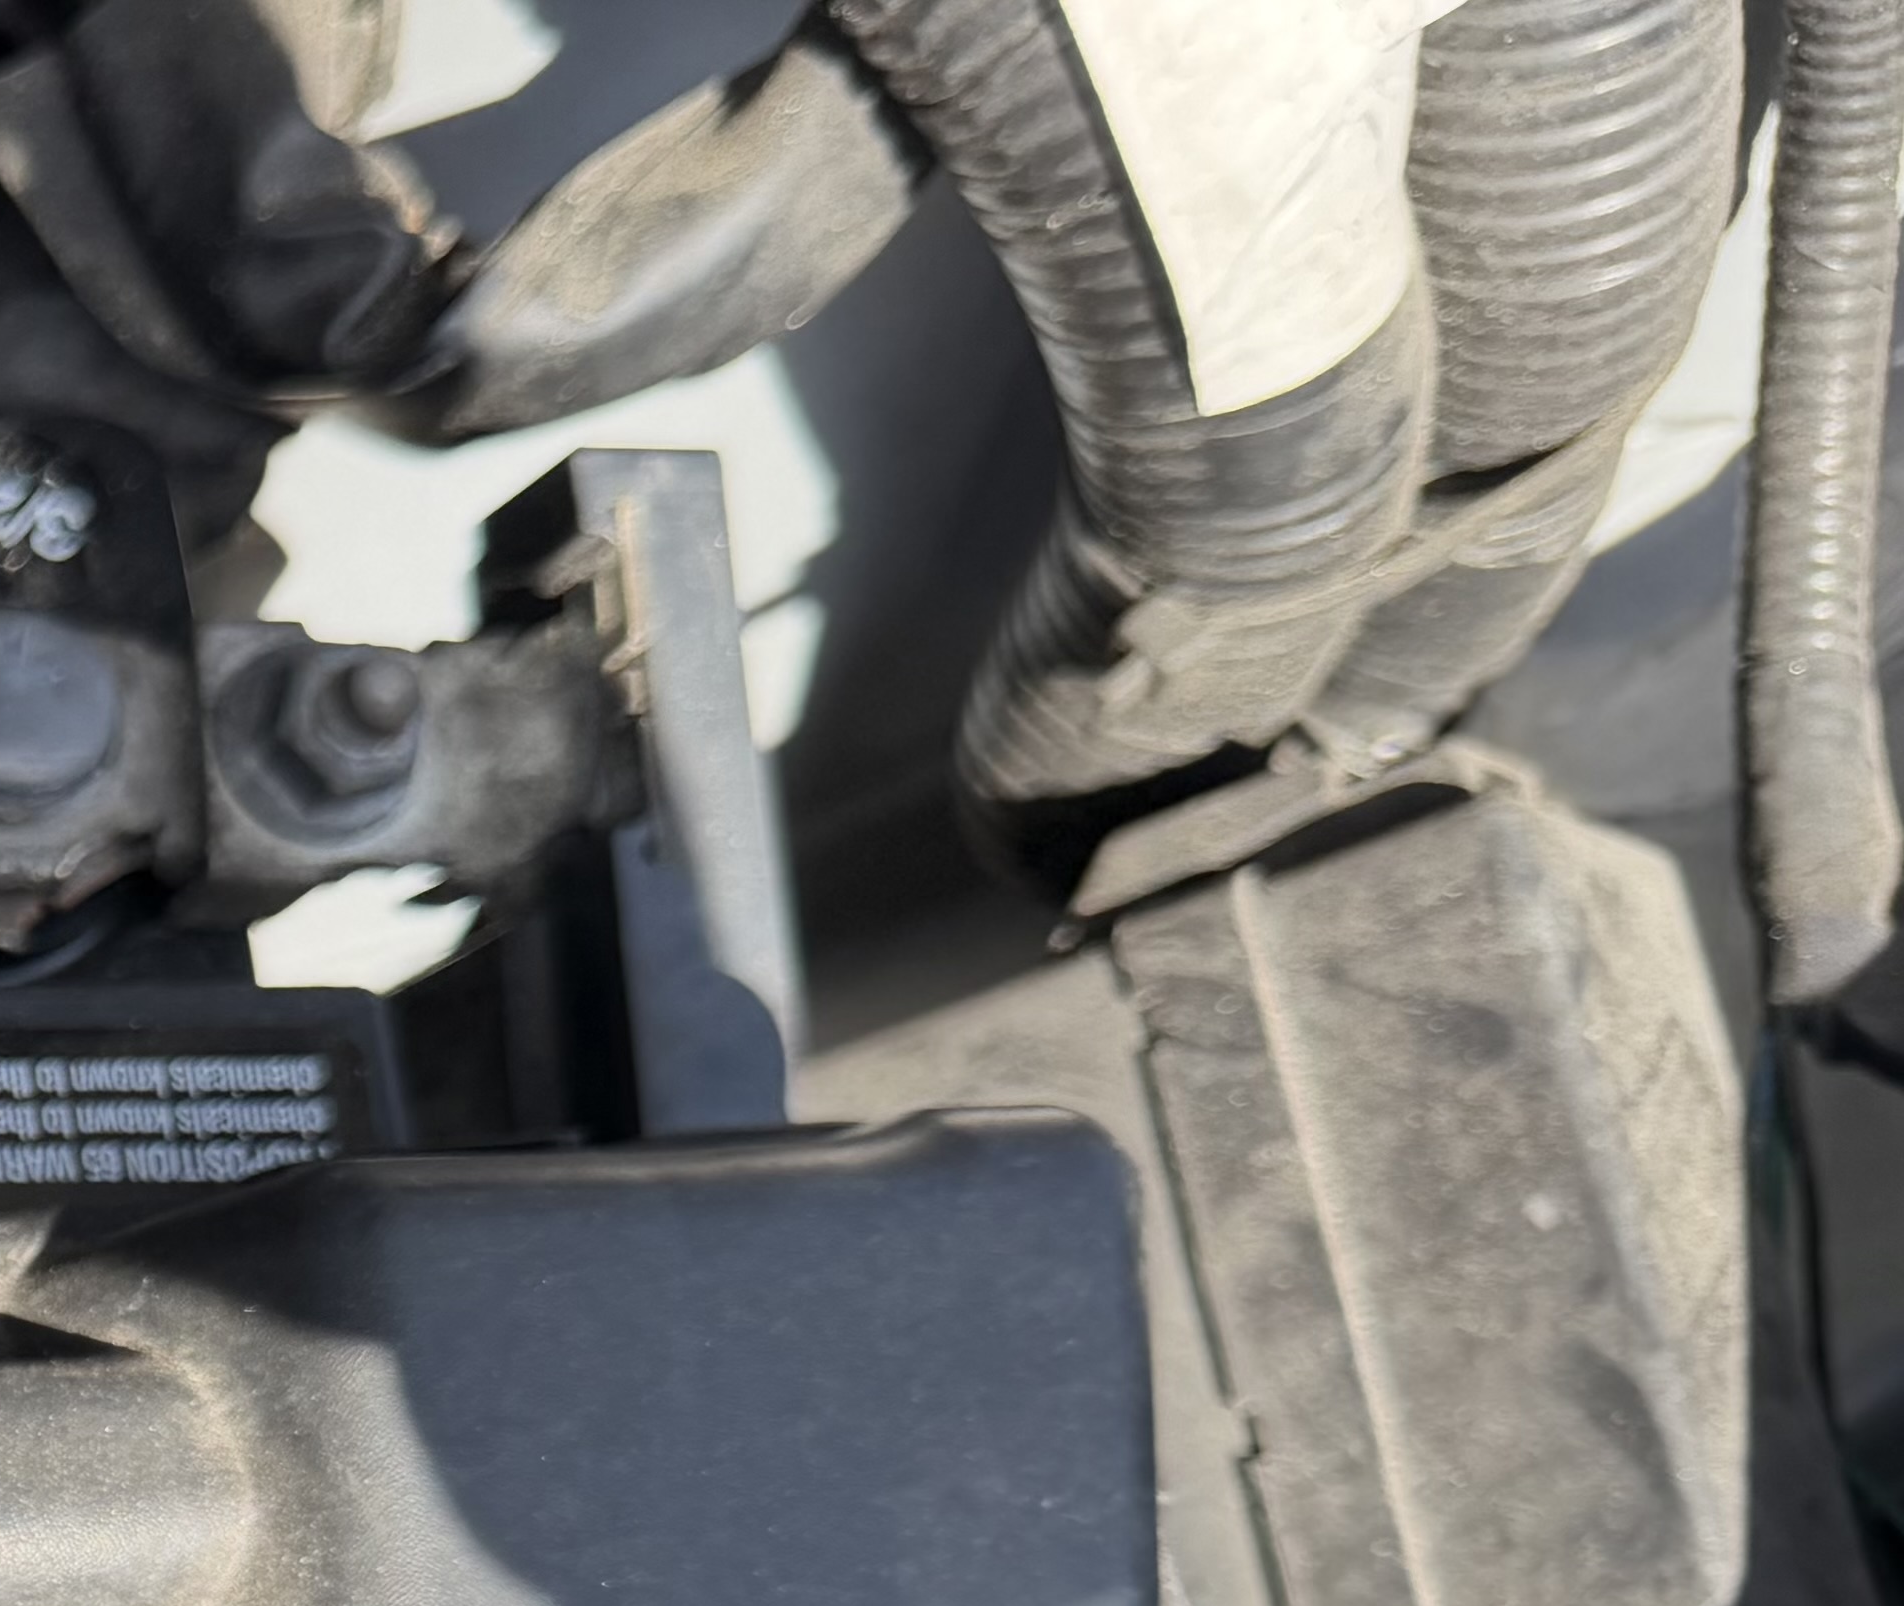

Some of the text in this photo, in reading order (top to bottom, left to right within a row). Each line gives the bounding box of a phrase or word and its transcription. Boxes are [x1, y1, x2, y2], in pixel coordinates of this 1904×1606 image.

[35, 1057, 70, 1098] to
[70, 1057, 168, 1099] known
[168, 1055, 330, 1097] chemicals
[42, 1099, 76, 1140] to
[76, 1098, 175, 1141] known
[175, 1096, 337, 1140] chemicals
[81, 1141, 123, 1182] 65
